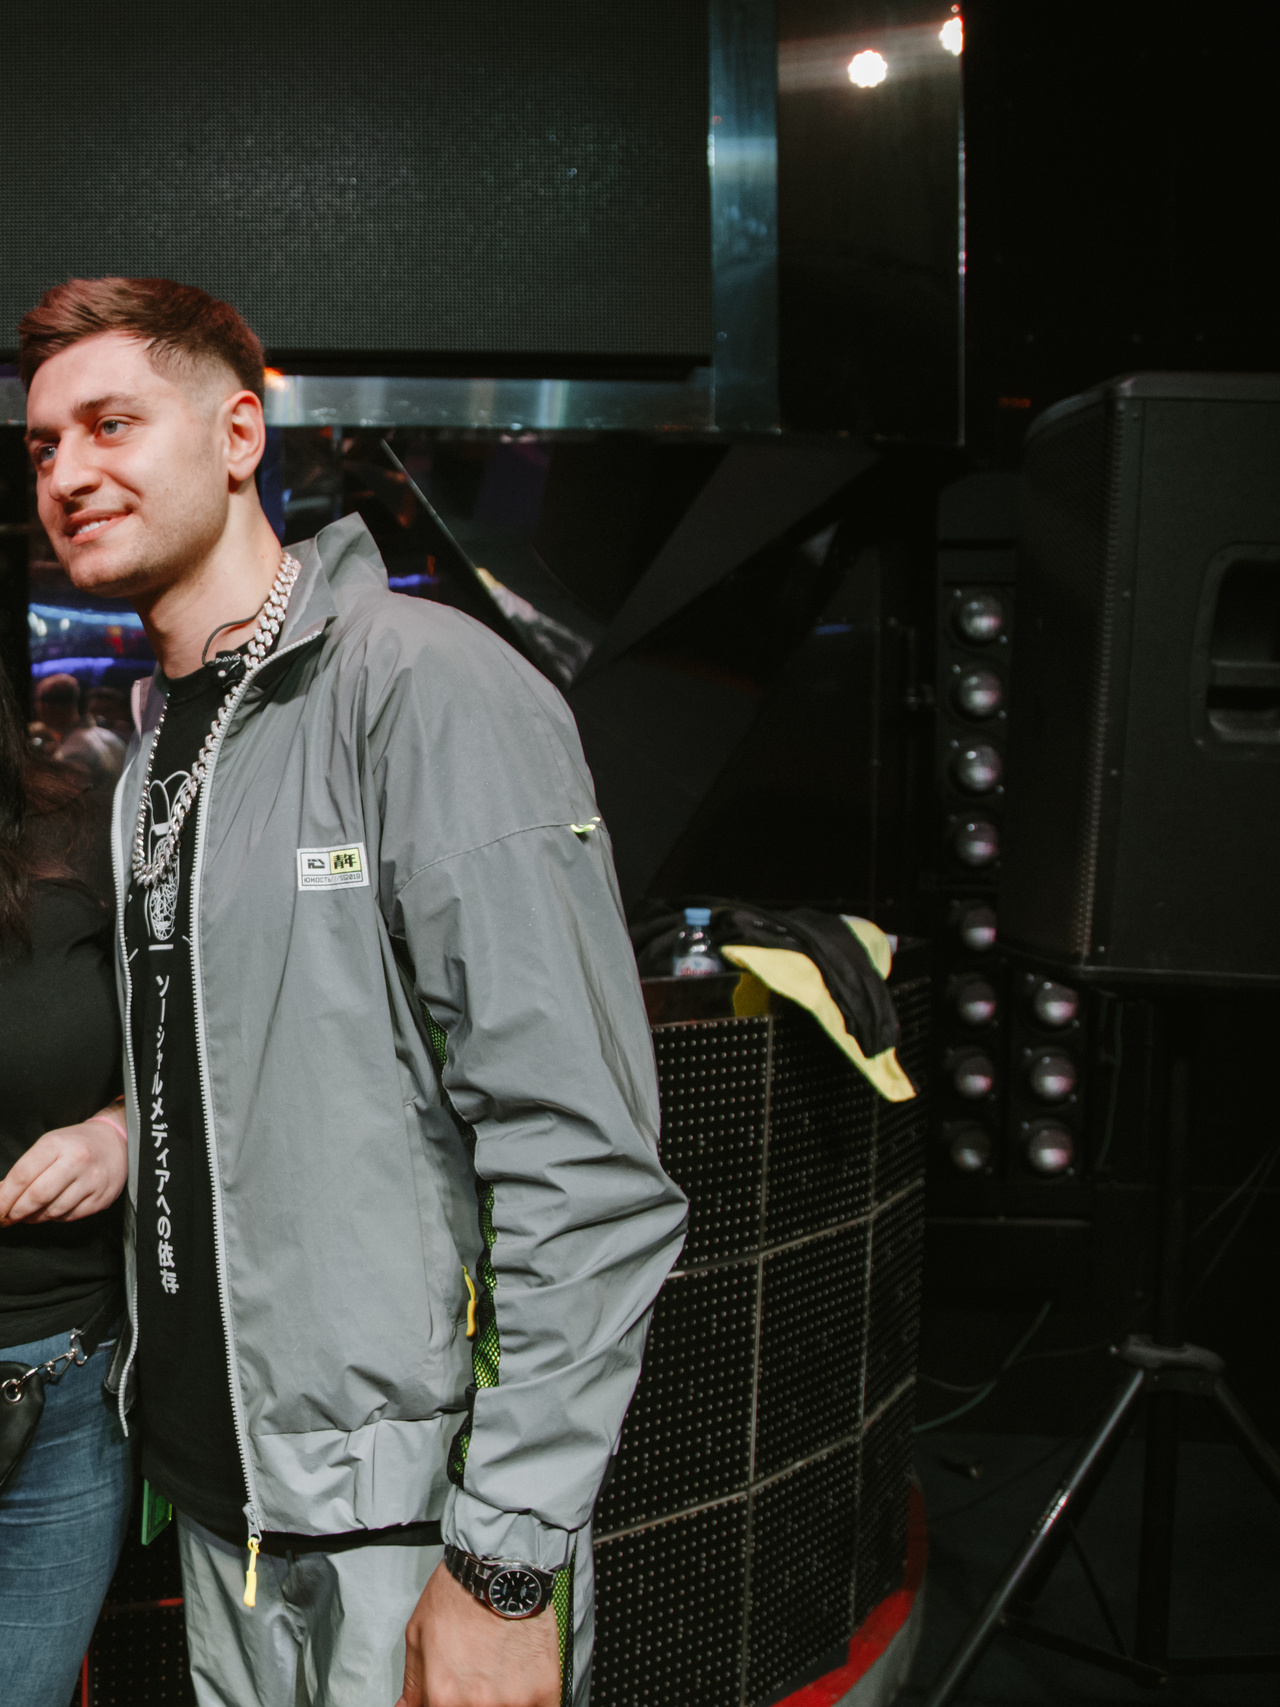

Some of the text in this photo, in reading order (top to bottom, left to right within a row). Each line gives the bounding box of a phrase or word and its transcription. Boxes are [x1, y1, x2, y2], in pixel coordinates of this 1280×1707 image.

[333, 853, 358, 870] 青年
[150, 974, 180, 1294] ソーシャルメディアへの依存
